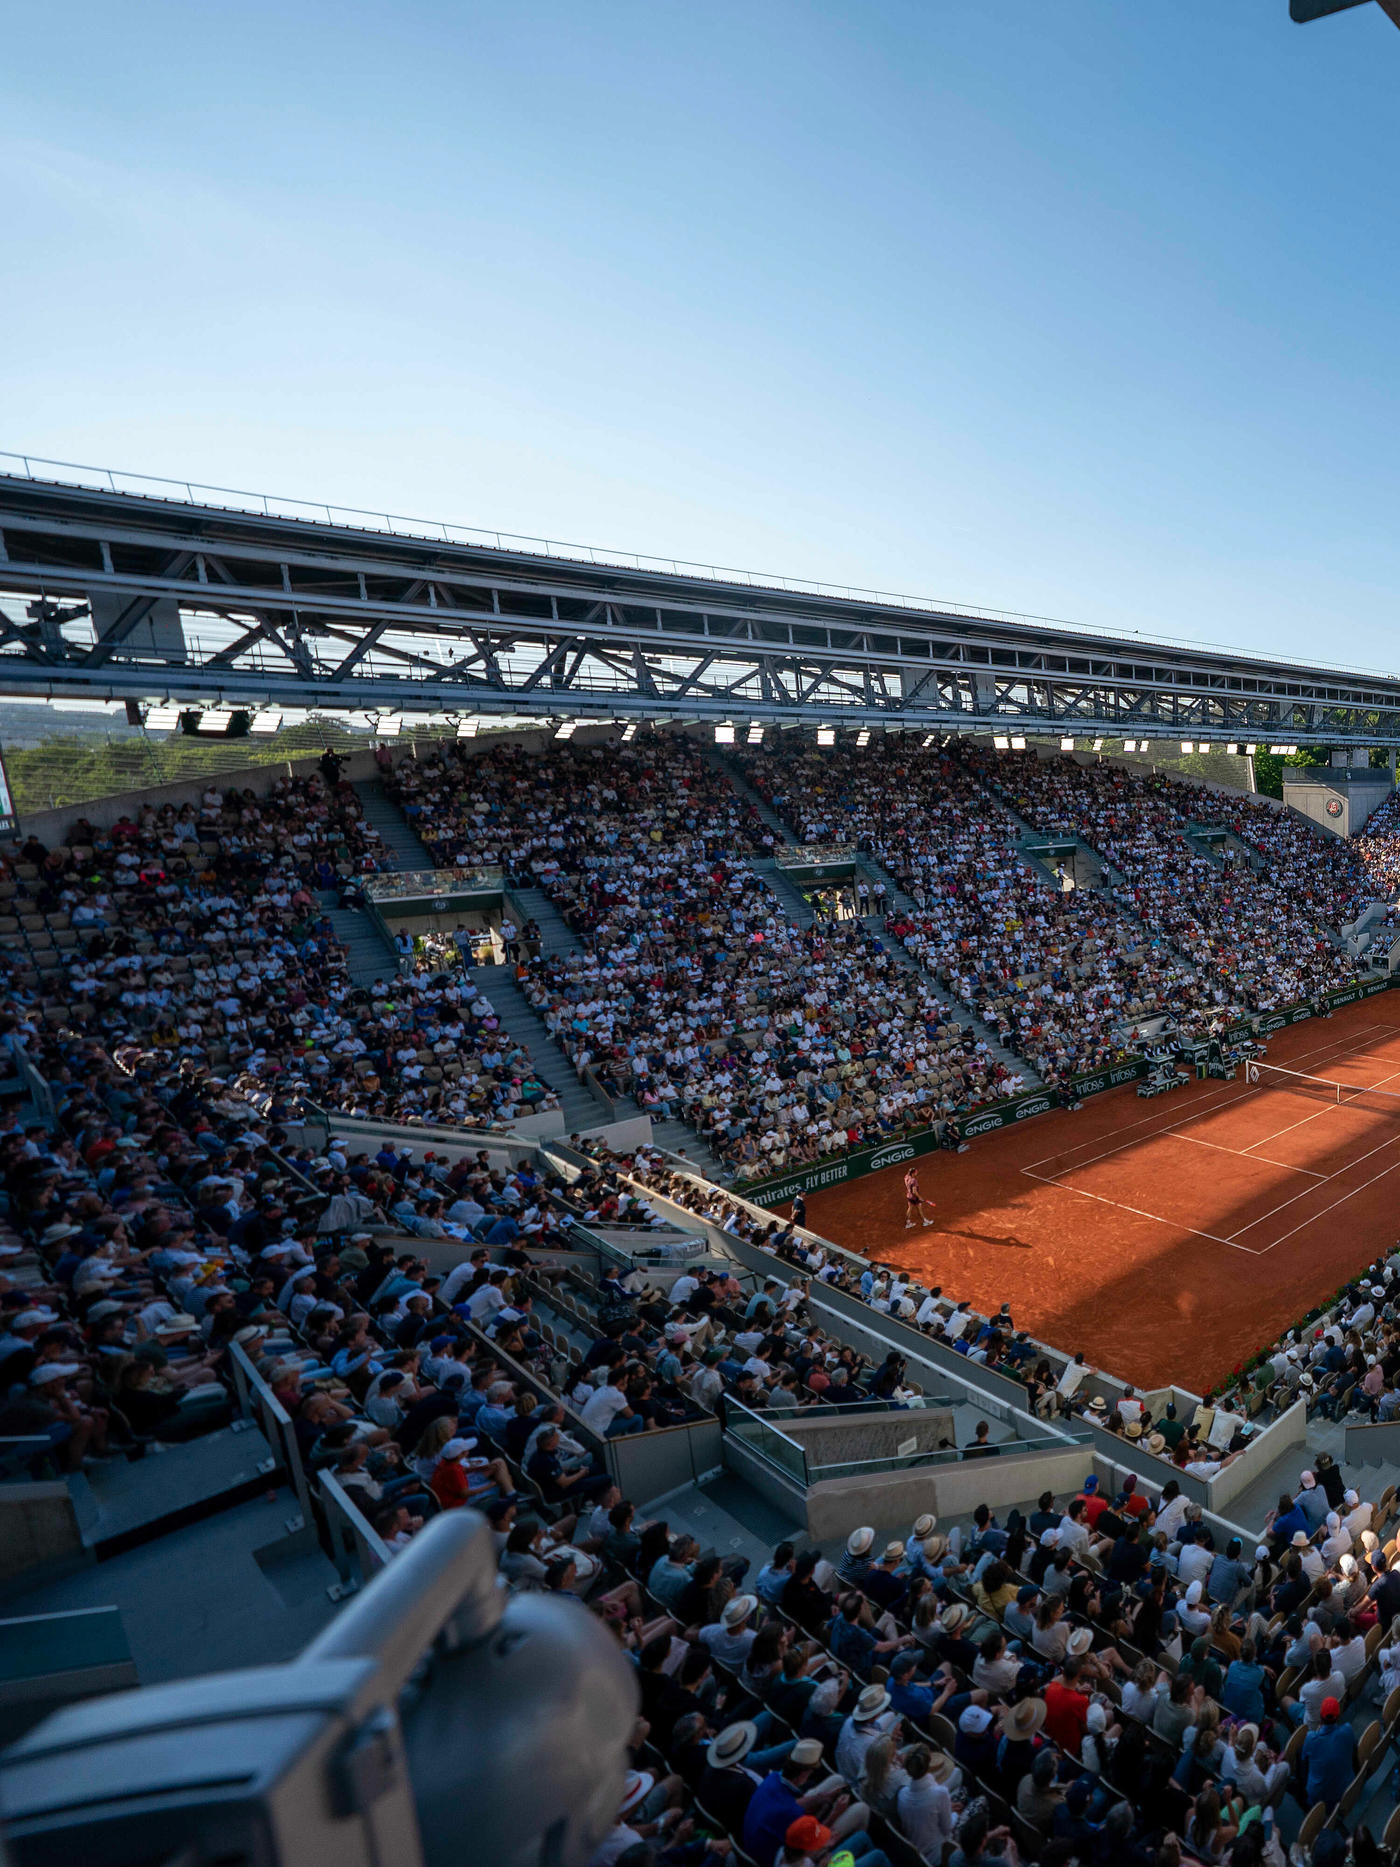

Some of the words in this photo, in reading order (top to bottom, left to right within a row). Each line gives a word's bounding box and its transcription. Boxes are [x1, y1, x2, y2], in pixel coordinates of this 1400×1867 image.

[1368, 981, 1388, 993] RENAULT
[1333, 993, 1356, 1006] RENAULT
[1228, 1029, 1249, 1043] Infosys
[1110, 1067, 1137, 1084] Infosys
[1076, 1078, 1105, 1095] Infosys
[805, 1175, 819, 1190] FLY
[820, 1165, 848, 1184] BETTER
